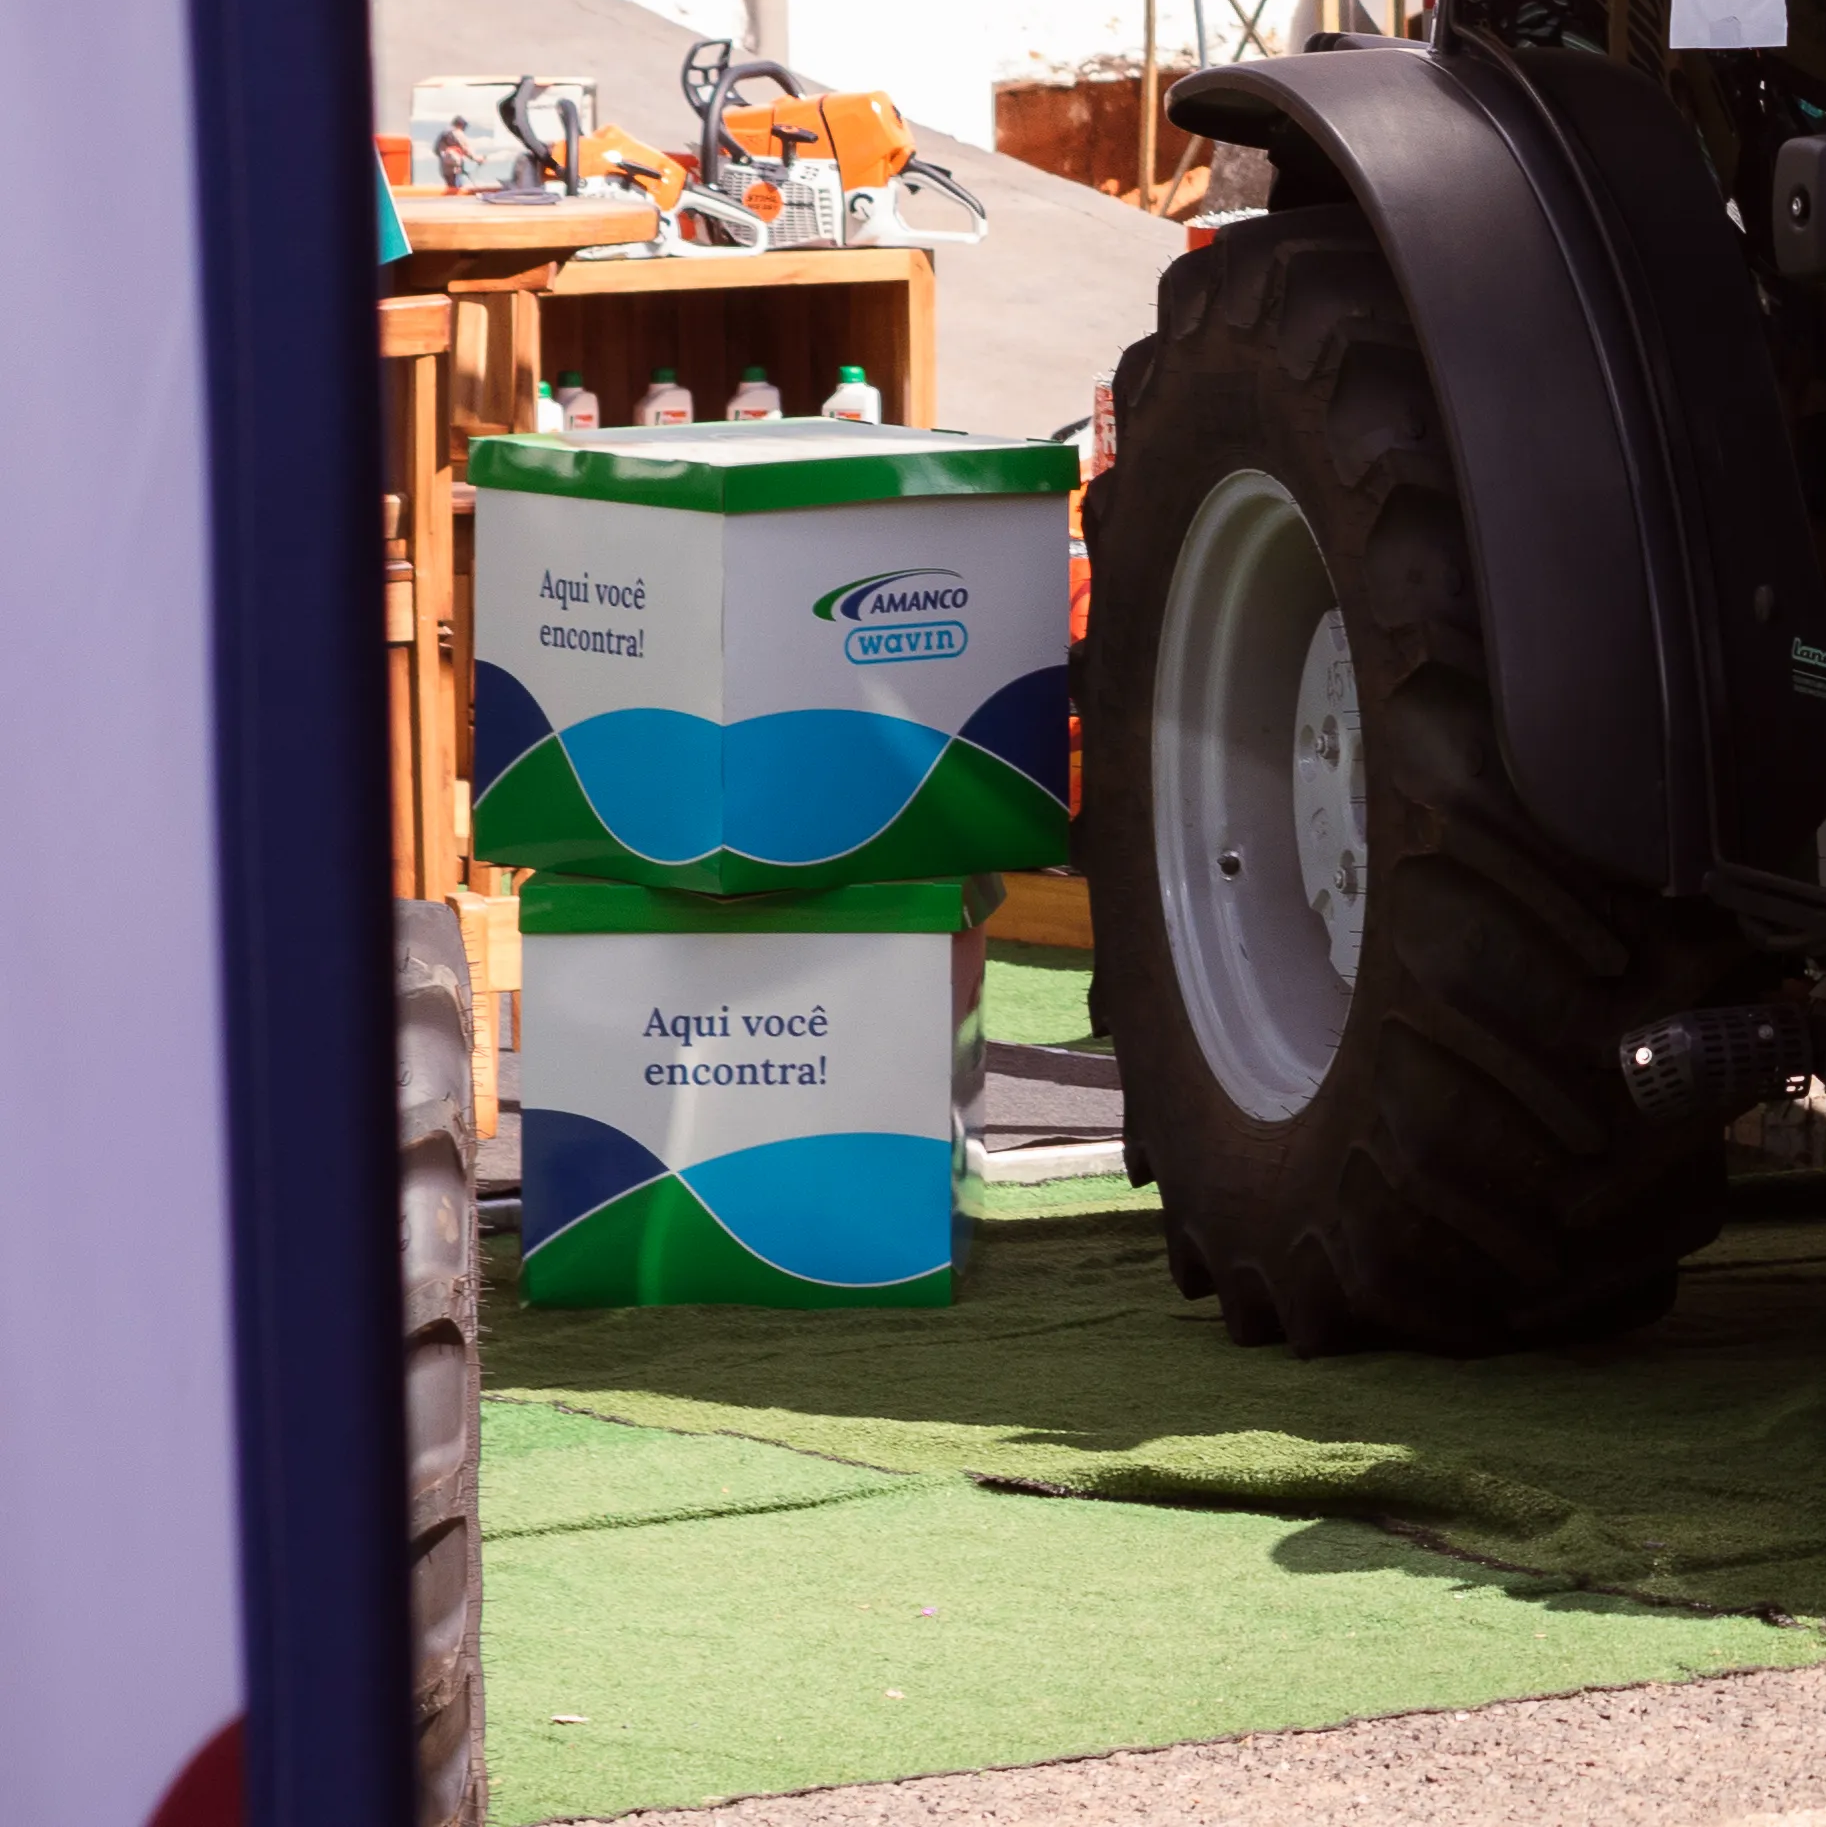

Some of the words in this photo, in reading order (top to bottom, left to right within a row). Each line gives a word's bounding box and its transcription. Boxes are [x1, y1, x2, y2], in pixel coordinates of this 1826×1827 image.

[539, 568, 589, 611] Aqui
[595, 577, 646, 610] você
[869, 587, 969, 615] AMANCO
[540, 623, 645, 658] encontra!
[857, 629, 955, 656] wavin
[642, 1005, 731, 1047] Aqui
[741, 1004, 829, 1037] você
[643, 1055, 827, 1086] encontra!
